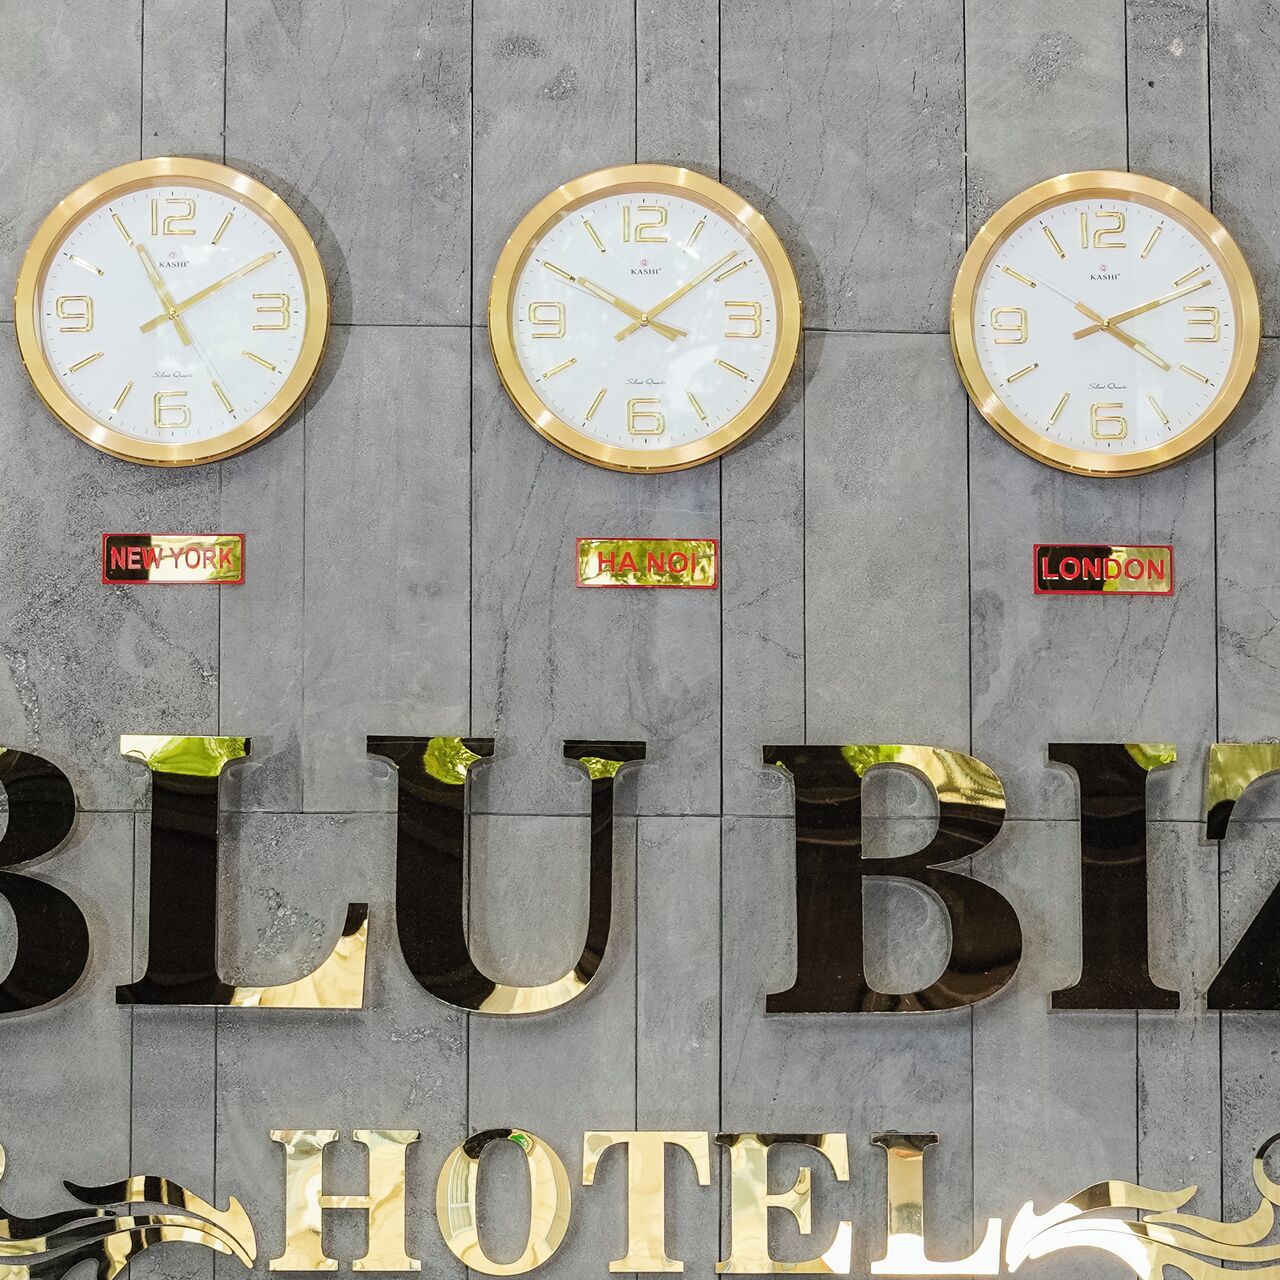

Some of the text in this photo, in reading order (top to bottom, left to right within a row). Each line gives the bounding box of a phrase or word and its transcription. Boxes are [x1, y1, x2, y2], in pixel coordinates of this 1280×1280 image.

[151, 198, 196, 235] 12
[622, 205, 668, 242] 12
[1080, 211, 1126, 249] 12
[56, 295, 93, 332] 9
[252, 293, 290, 330] 3
[528, 302, 566, 339] 9
[724, 301, 762, 338] 3
[991, 307, 1028, 344] 9
[1183, 306, 1220, 343] 3
[153, 390, 191, 428] 6
[627, 398, 665, 435] 6
[1090, 402, 1128, 440] 6
[110, 546, 234, 570] NEW YORK
[597, 551, 696, 574] HA NOI
[1041, 555, 1166, 581] LONDON
[267, 1127, 1003, 1277] HOTEL
